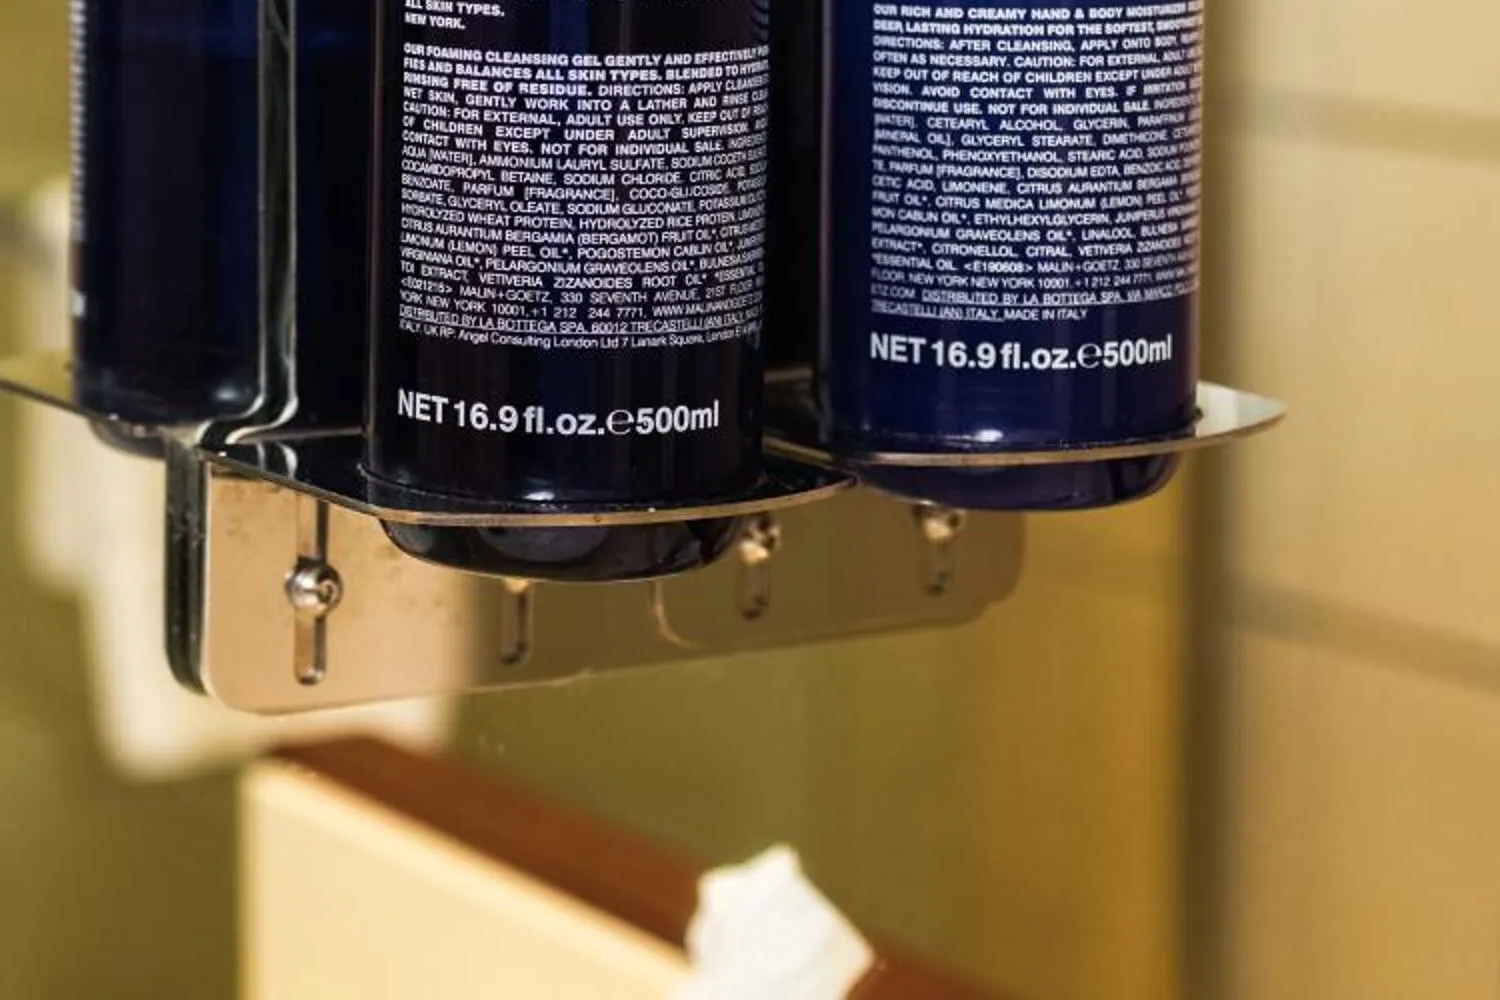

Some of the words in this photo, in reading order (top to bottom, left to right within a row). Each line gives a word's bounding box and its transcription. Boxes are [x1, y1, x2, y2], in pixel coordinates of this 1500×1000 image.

[425, 0, 453, 12] SKIN
[457, 2, 504, 16] TYPES.
[900, 5, 930, 17] RICH
[935, 6, 964, 18] AND
[968, 7, 1026, 19] CREAMY
[1030, 8, 1070, 19] HAND
[1073, 8, 1084, 19] &
[1089, 7, 1122, 19] BODY
[404, 12, 426, 25] NEW
[429, 16, 466, 29] YORK.
[906, 21, 960, 34] LASTING
[963, 23, 1044, 35] HYDRATION
[1047, 24, 1074, 35] FOR
[1076, 23, 1102, 35] THE
[948, 39, 990, 50] AFTER
[1080, 38, 1118, 50] APPLY
[1122, 37, 1151, 49] ONTO
[426, 45, 482, 61] FOAMING
[485, 50, 568, 65] CLEANSING
[571, 54, 601, 66] GEL
[604, 54, 661, 66] GENTLY
[663, 53, 692, 65] AND
[873, 49, 907, 63] OFTEN
[910, 52, 926, 64] AS
[929, 53, 1010, 67] NECESSARY.
[1014, 55, 1075, 67] CAUTION:
[1079, 54, 1104, 66] FOR
[427, 60, 452, 73] AND
[455, 63, 532, 79] BALANCES
[536, 68, 564, 80] ALL
[568, 69, 605, 80] SKIN
[610, 69, 662, 81] TYPES.
[666, 66, 722, 80] BLENDED
[725, 64, 738, 76] TO
[872, 65, 900, 78] KEEP
[903, 68, 928, 80] OUT
[931, 69, 949, 81] OF
[952, 70, 998, 83] REACH
[1002, 71, 1021, 83] OF
[1024, 71, 1092, 83] CHILDREN
[1095, 69, 1138, 82] EXCEPT
[454, 77, 488, 91] FREE
[493, 81, 513, 93] OF
[519, 82, 592, 95] RESIDUE.
[598, 83, 684, 96] DIRECTIONS:
[688, 80, 721, 93] APPLY
[921, 85, 960, 97] AVOID
[969, 87, 1033, 99] CONTACT
[1043, 87, 1076, 98] WITH
[1085, 86, 1118, 98] EYES.
[1126, 85, 1136, 96] IF
[465, 93, 516, 108] GENTLY
[524, 97, 568, 110] WORK
[577, 99, 612, 110] INTO
[620, 99, 630, 110] A
[637, 98, 686, 110] LATHER
[694, 96, 716, 108] AND
[953, 102, 982, 114] USE.
[987, 103, 1016, 114] NOT
[1020, 103, 1048, 115] FOR
[1052, 101, 1118, 114] INDIVIDUAL
[453, 107, 480, 120] FOR
[483, 109, 560, 126] EXTERNAL,
[566, 114, 612, 125] ADULT
[617, 114, 644, 125] USE
[688, 110, 716, 123] KEEP
[927, 117, 990, 130] CETEARYL
[423, 118, 482, 135] CHILDREN
[496, 125, 550, 139] EXCEPT
[564, 129, 614, 140] UNDER
[627, 128, 670, 140] ADULT
[402, 129, 448, 146] CONTACT
[454, 136, 486, 150] WITH
[494, 140, 533, 153] EYES.
[541, 143, 571, 155] NOT
[578, 144, 608, 155] FOR
[615, 142, 688, 155] INDIVIDUAL
[961, 134, 1024, 146] GLYCERYL
[479, 153, 552, 169] AMMONIUM
[556, 158, 606, 170] LAURYL
[1068, 149, 1116, 162] STEARIC
[563, 173, 614, 185] SODIUM
[1027, 166, 1088, 178] DISODIUM
[463, 182, 514, 197] PARFUM
[1016, 182, 1062, 194] CITRUS
[447, 194, 507, 211] GLYCERYL
[567, 202, 619, 214] SODIUM
[935, 195, 980, 209] CITRUS
[985, 197, 1034, 210] MEDICA
[468, 211, 510, 226] WHEAT
[579, 216, 664, 229] HYDROLYZED
[667, 215, 692, 227] RICE
[436, 222, 502, 240] AURANTIUM
[505, 230, 574, 244] BERGAMIA
[661, 229, 694, 243] FRUIT
[502, 245, 535, 257] PEEL
[577, 246, 670, 259] POGOSTEMON
[486, 258, 580, 273] PELARGONIUM
[584, 261, 670, 274] GRAVEOLENS
[479, 272, 542, 287] VETIVERIA
[642, 275, 676, 287] ROOT
[936, 274, 968, 287] YORK
[970, 276, 998, 288] NEW
[1000, 277, 1035, 289] YORK
[560, 292, 582, 303] 330
[589, 291, 646, 303] SEVENTH
[1003, 293, 1019, 305] BY
[1023, 293, 1039, 305] LA
[426, 294, 449, 308] NEW
[454, 298, 485, 312] YORK
[554, 306, 576, 318] 212
[588, 307, 610, 318] 244
[1004, 308, 1039, 320] MADE
[1042, 308, 1054, 320] IN
[1057, 307, 1088, 320] ITALY
[480, 316, 494, 329] LA
[497, 318, 556, 333] BOTTEGA
[459, 329, 488, 344] Angel
[491, 332, 550, 348] Consulting
[553, 336, 597, 347] London
[622, 336, 628, 347] 7
[870, 332, 926, 364] NET
[932, 340, 996, 369] 16.9
[398, 388, 448, 424] NET
[453, 399, 519, 432] 16.9
